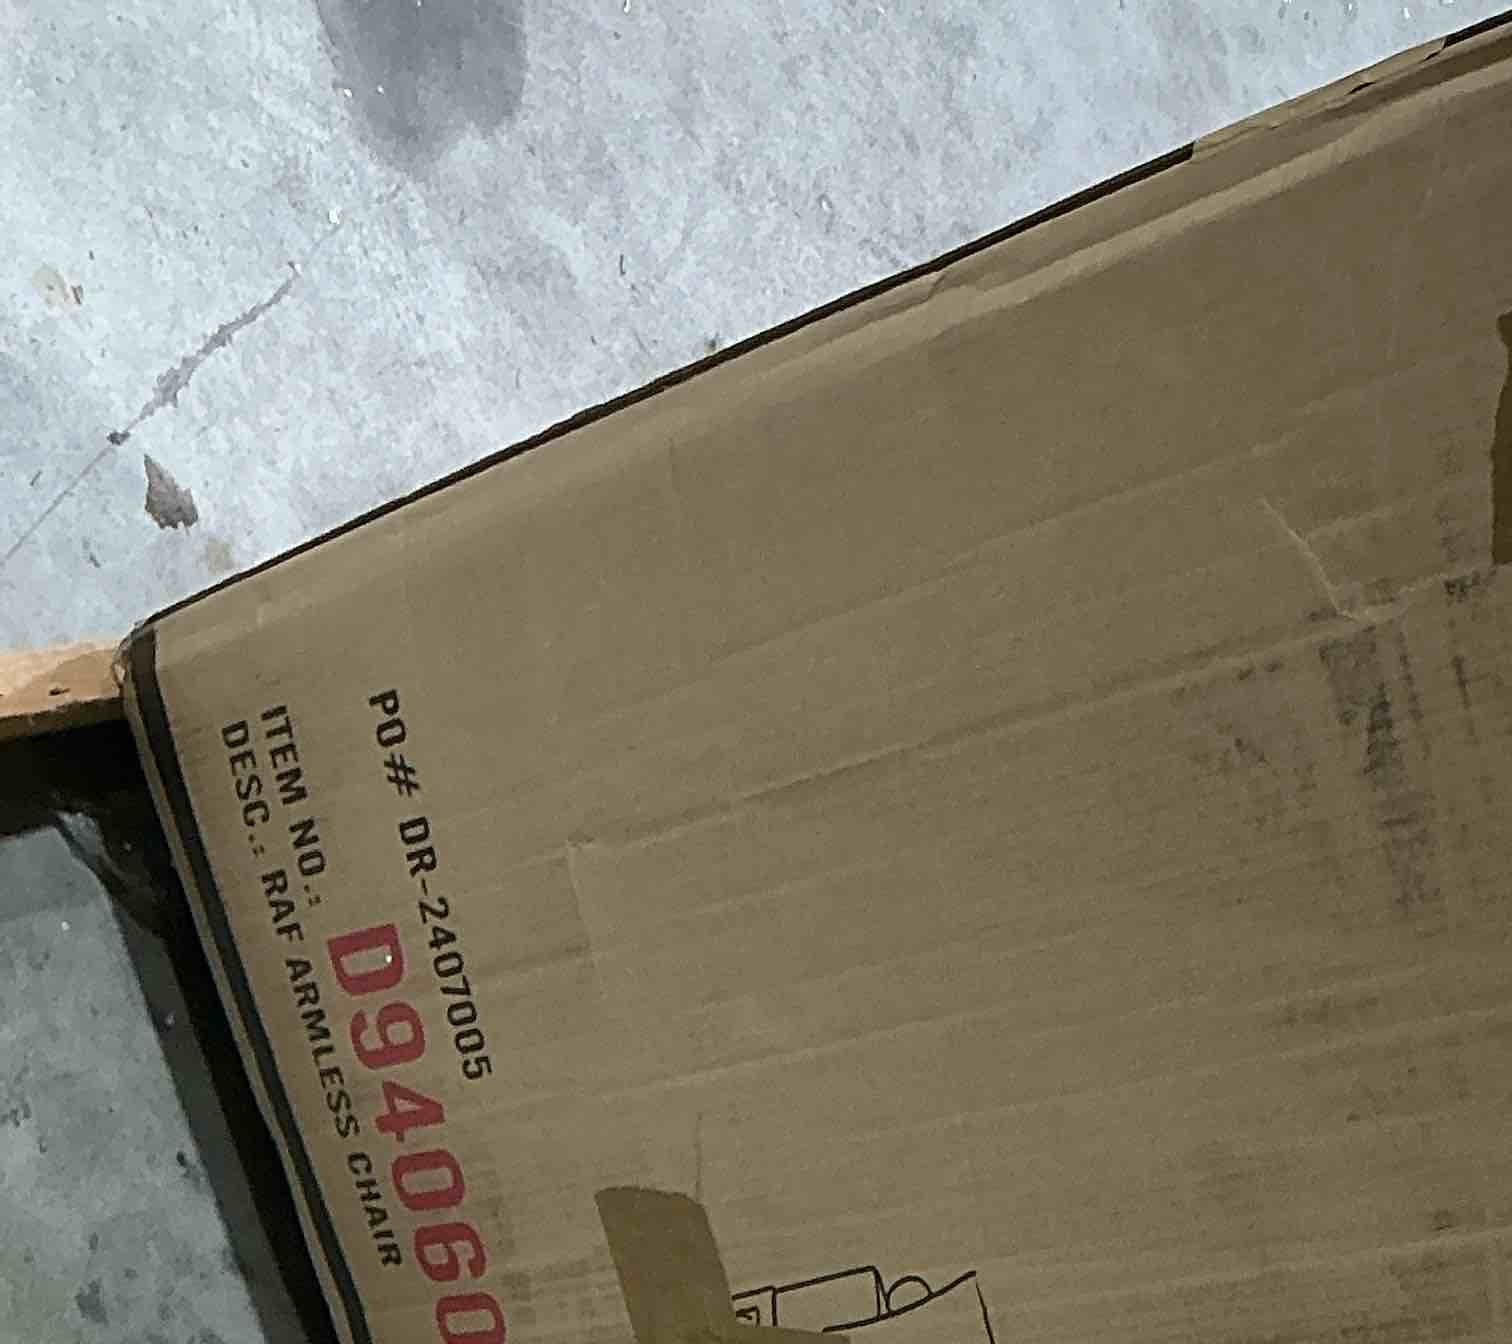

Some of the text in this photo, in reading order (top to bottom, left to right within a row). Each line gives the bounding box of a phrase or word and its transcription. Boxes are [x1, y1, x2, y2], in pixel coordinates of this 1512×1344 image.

[260, 704, 308, 806] ITEM
[260, 868, 305, 944] RAF
[284, 956, 361, 1140] ARMLESS
[346, 1151, 402, 1268] CHAIR
[399, 816, 492, 1080] DR-2407005
